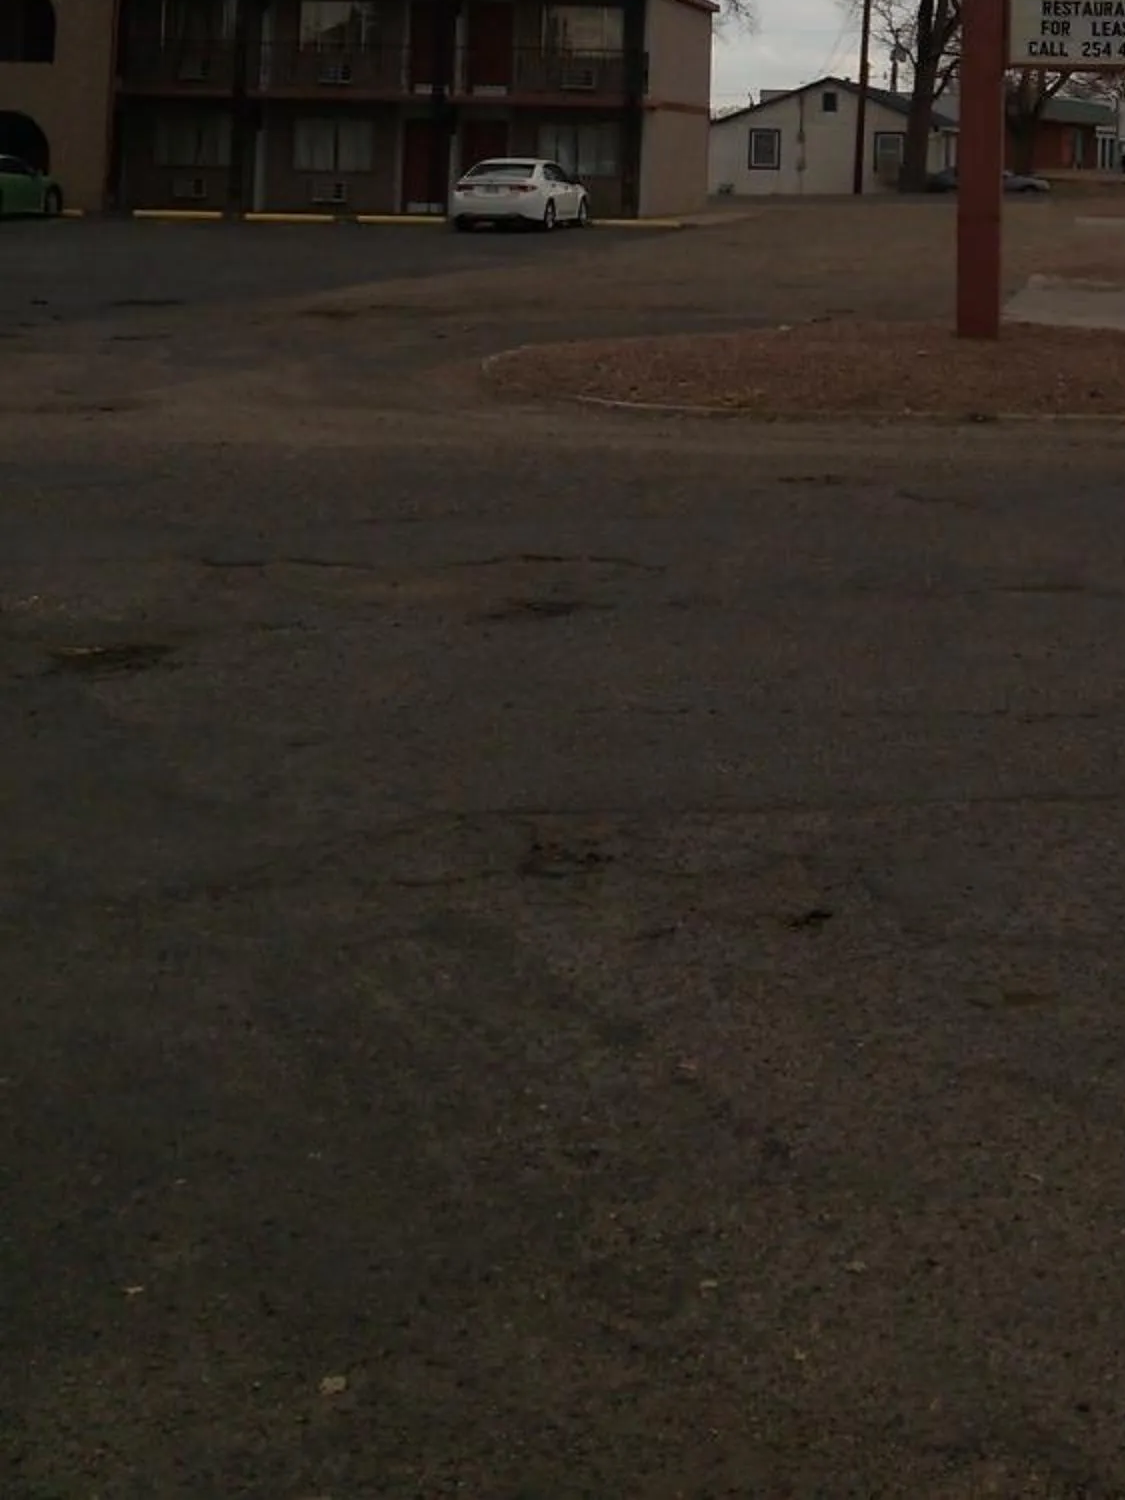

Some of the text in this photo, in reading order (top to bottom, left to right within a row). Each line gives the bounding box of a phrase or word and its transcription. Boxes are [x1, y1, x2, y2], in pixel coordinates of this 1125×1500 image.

[1040, 21, 1070, 37] FOR
[1027, 41, 1068, 58] CALL
[1082, 42, 1112, 57] 254
